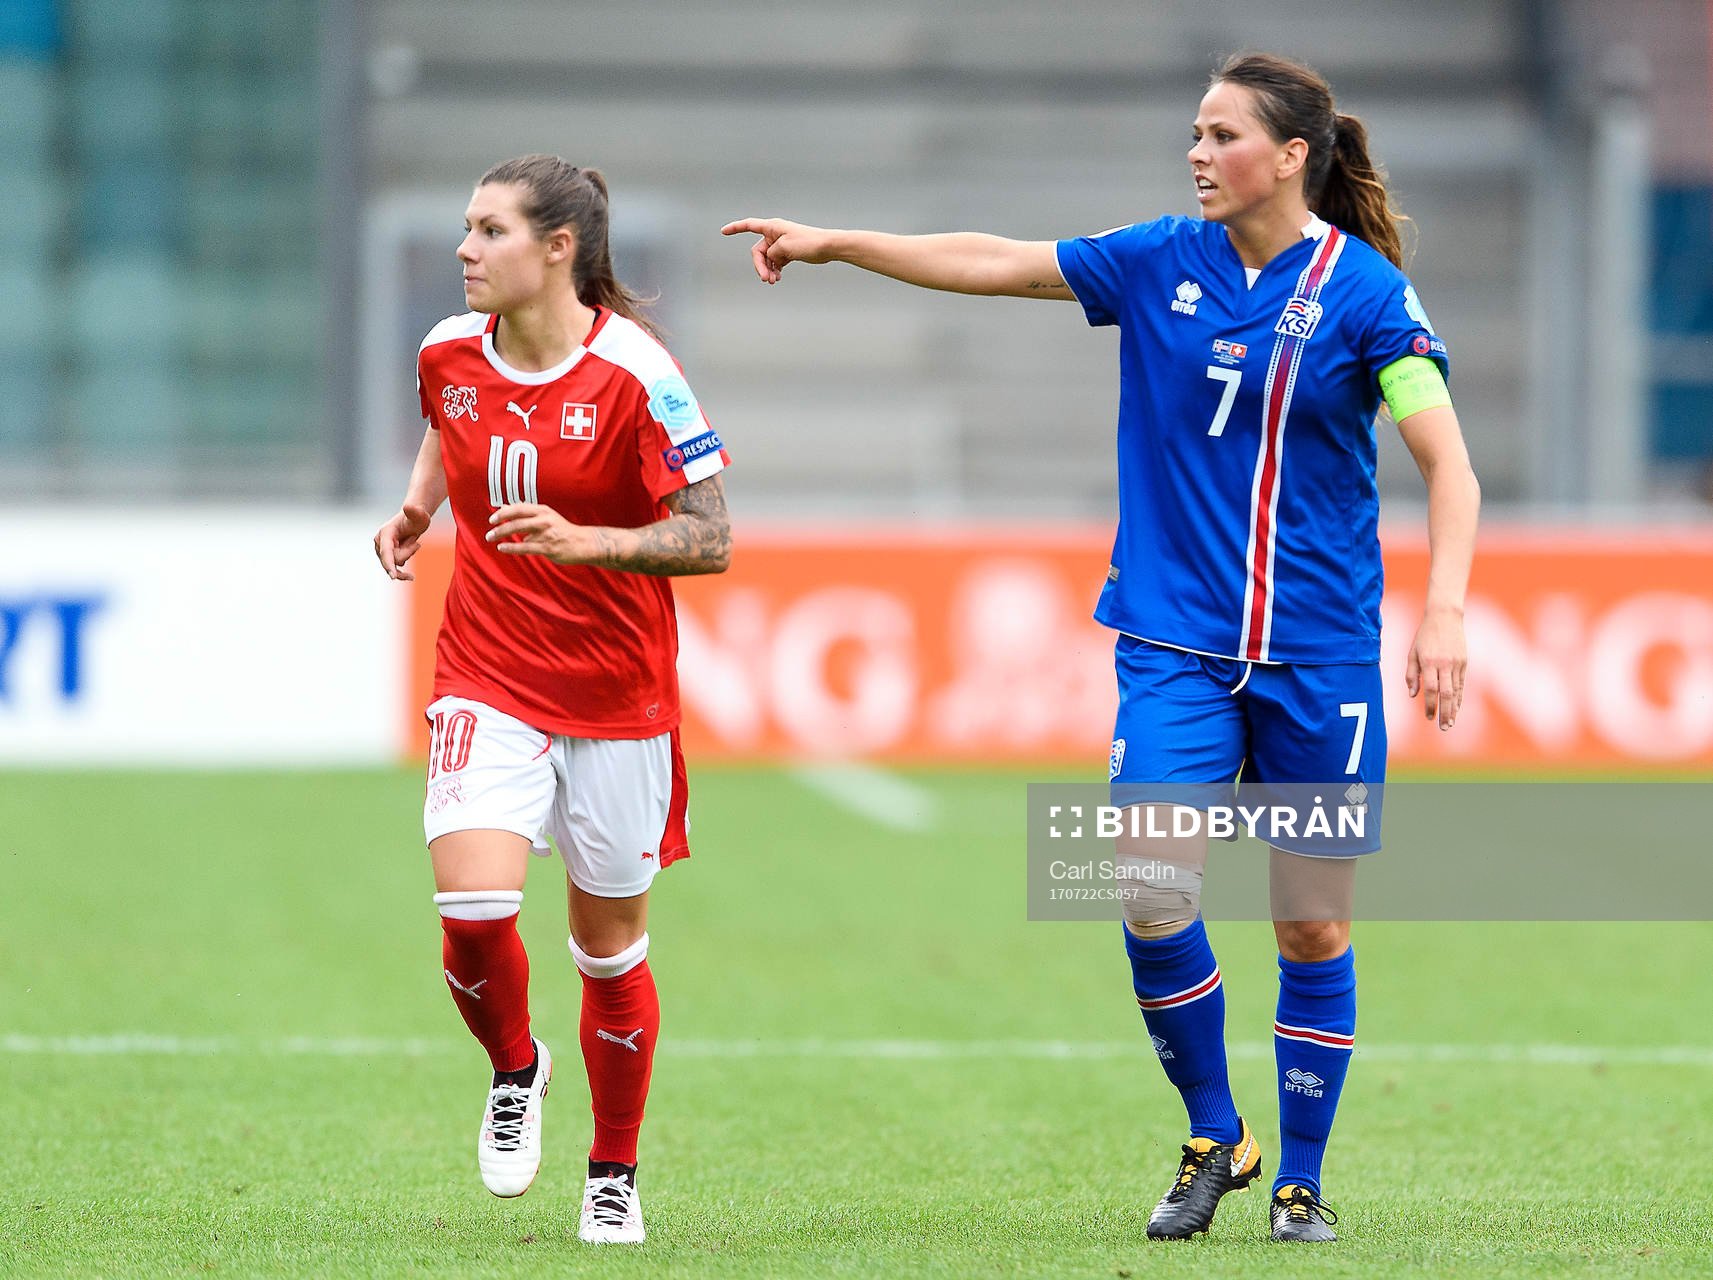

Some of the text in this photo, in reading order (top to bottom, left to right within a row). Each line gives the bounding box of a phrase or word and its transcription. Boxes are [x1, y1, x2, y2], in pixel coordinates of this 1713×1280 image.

[1206, 365, 1243, 438] 7
[488, 434, 538, 508] 10
[683, 433, 720, 458] RESPEC
[673, 586, 917, 758] NG
[432, 709, 478, 780] 10
[1339, 702, 1368, 775] 7
